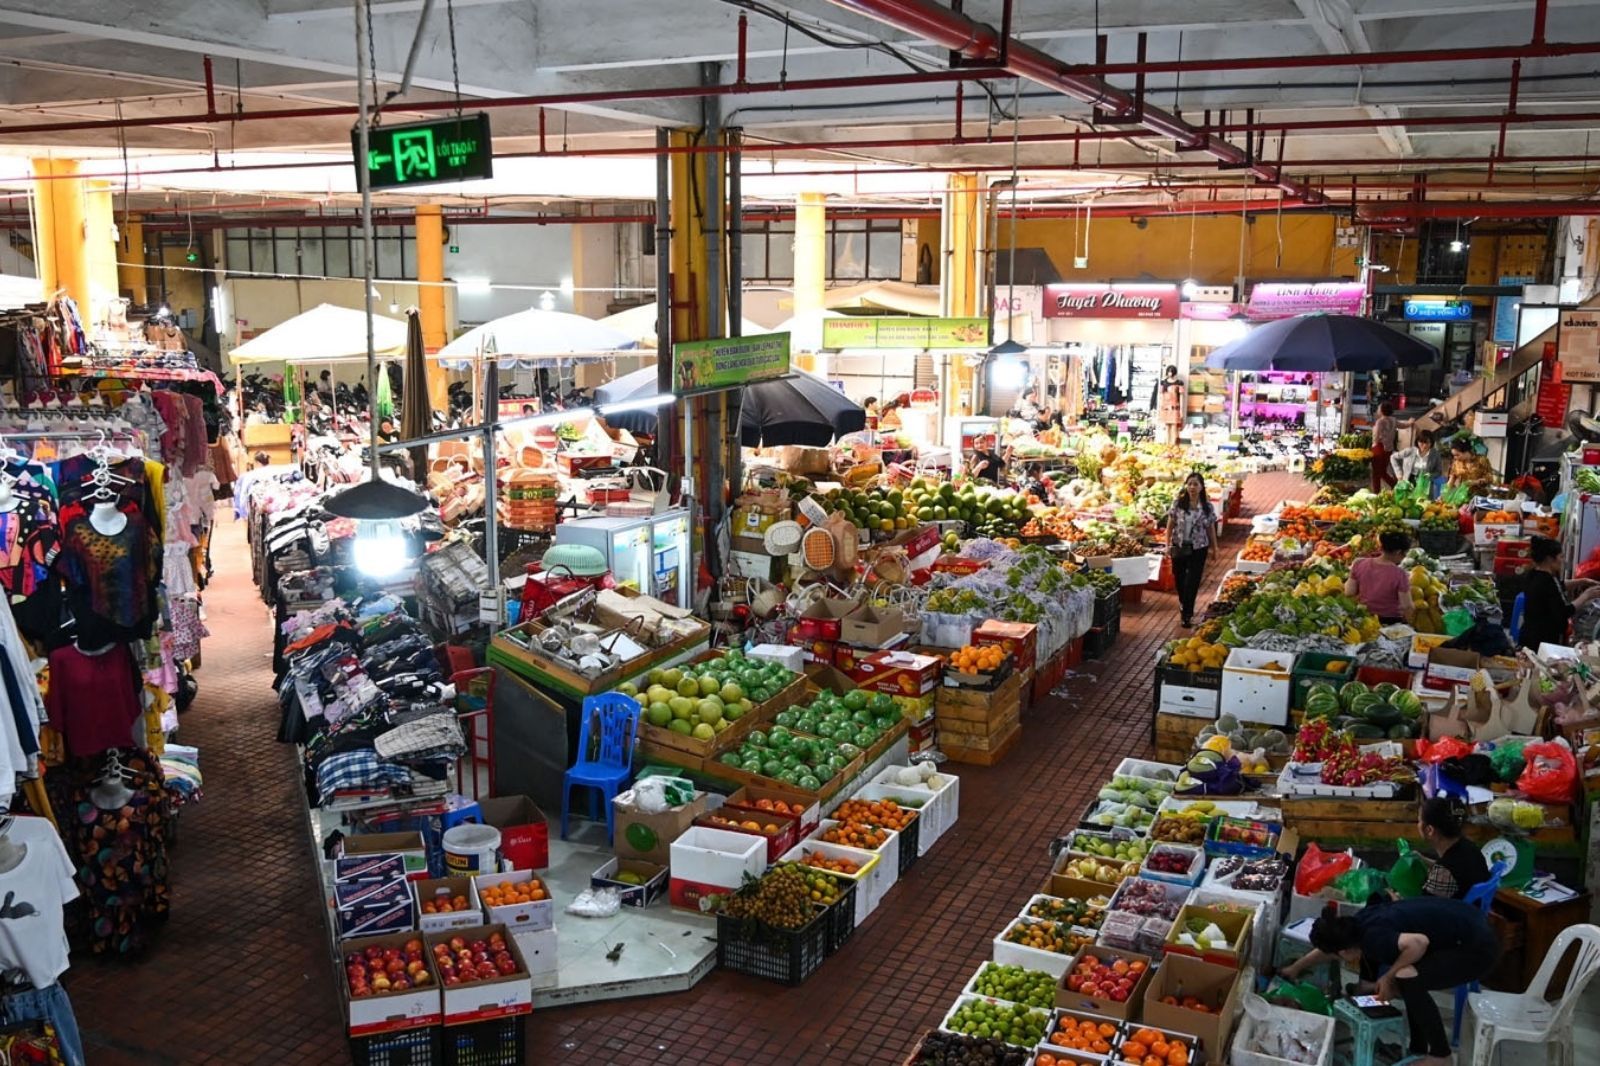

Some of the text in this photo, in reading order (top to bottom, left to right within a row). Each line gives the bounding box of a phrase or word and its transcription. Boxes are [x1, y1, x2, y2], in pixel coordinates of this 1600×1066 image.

[450, 138, 477, 156] THOÁT
[1101, 290, 1162, 311] Phương
[1564, 314, 1598, 327] davines
